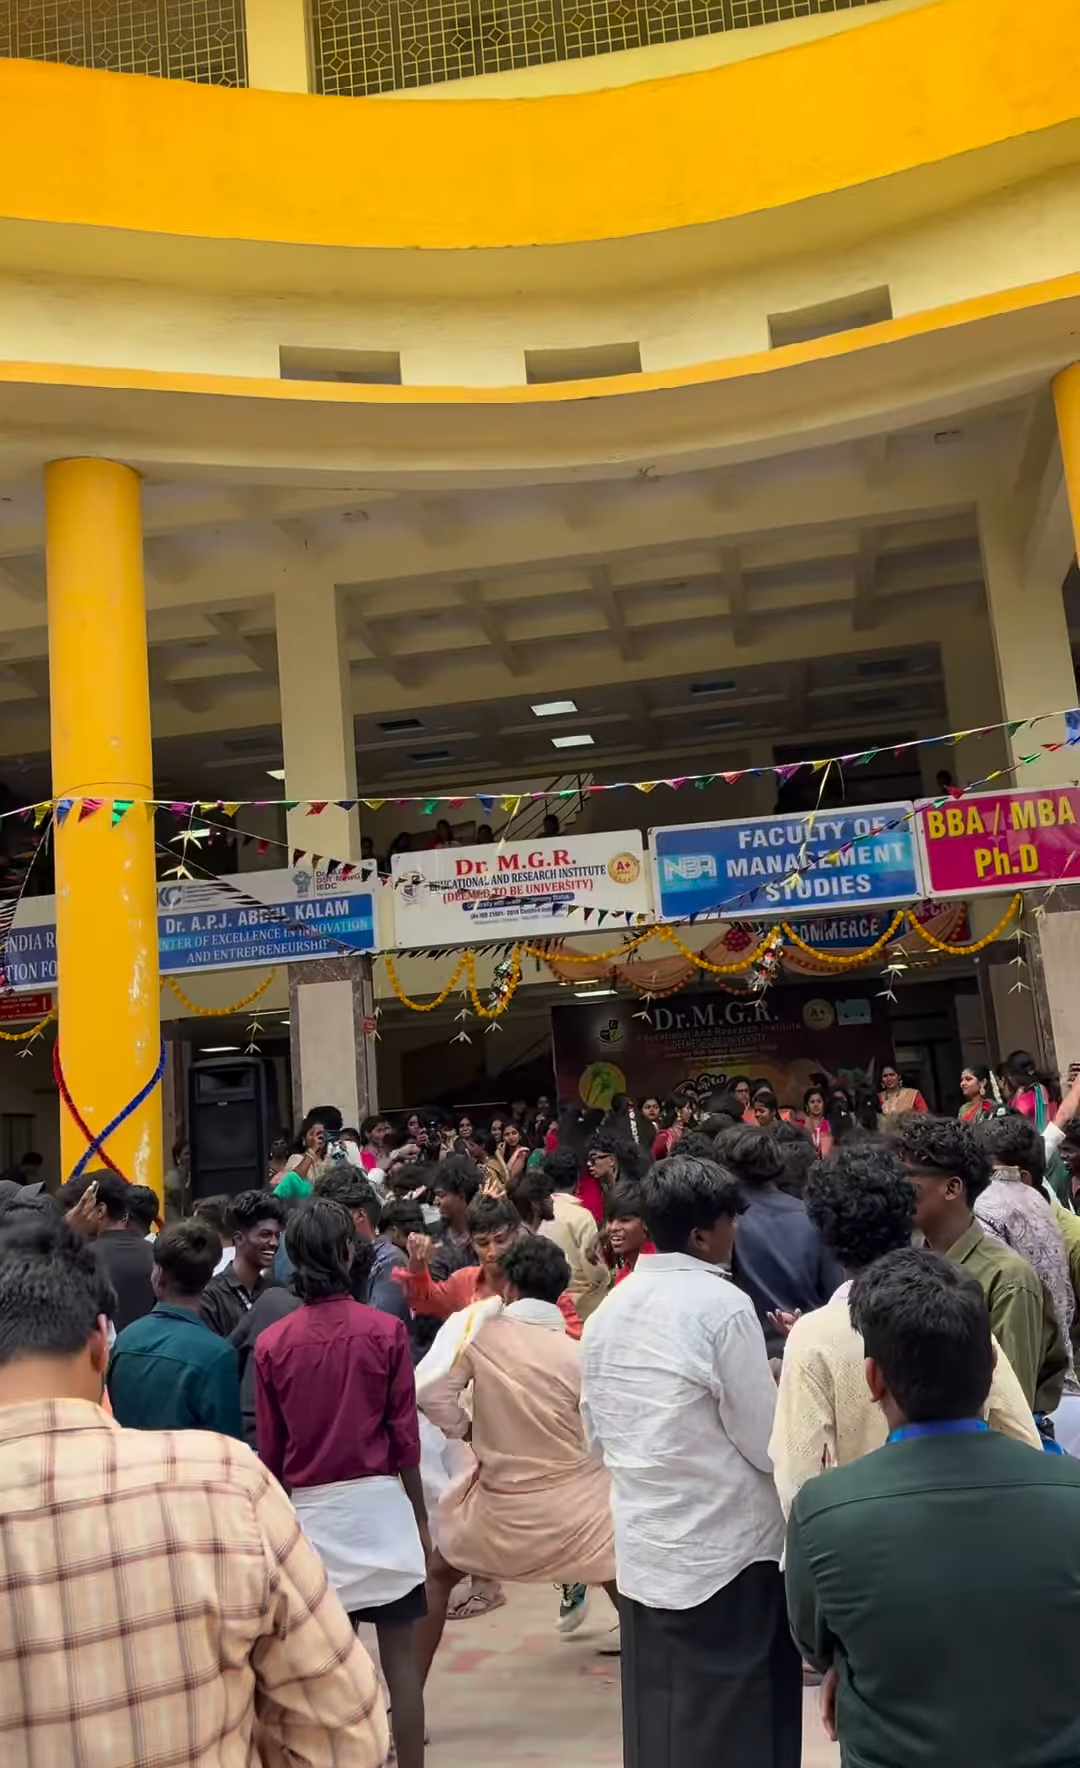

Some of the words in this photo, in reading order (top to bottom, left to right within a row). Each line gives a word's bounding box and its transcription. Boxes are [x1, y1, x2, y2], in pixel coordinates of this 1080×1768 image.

[927, 805, 985, 840] BBA
[992, 802, 1000, 836] /
[1009, 796, 1077, 831] MBA
[738, 819, 843, 850] FACULTY
[854, 816, 887, 837] OF
[497, 849, 577, 872] M.G.R.
[617, 861, 631, 871] A+
[664, 854, 717, 881] NBA
[726, 842, 906, 878] MANAGEMENT
[974, 843, 1039, 878] Ph.D
[491, 873, 510, 885] AND
[511, 868, 557, 883] RESEARCH
[559, 864, 607, 879] INSTITUTE
[494, 887, 507, 897] TO
[510, 885, 524, 895] BE
[526, 879, 594, 894] UNIVERSITY)
[765, 873, 872, 902] STUDIES
[166, 918, 186, 934] Dr.
[191, 913, 233, 931] A.P.J.
[295, 900, 350, 920] KALAM
[159, 937, 192, 951] NTER
[195, 935, 209, 948] OF
[212, 928, 281, 946] EXCELLENCE
[300, 919, 368, 938] INNOVATION
[187, 950, 211, 964] AND
[214, 938, 330, 961] ENTREPRENEURSHIP
[4, 962, 37, 982] TION
